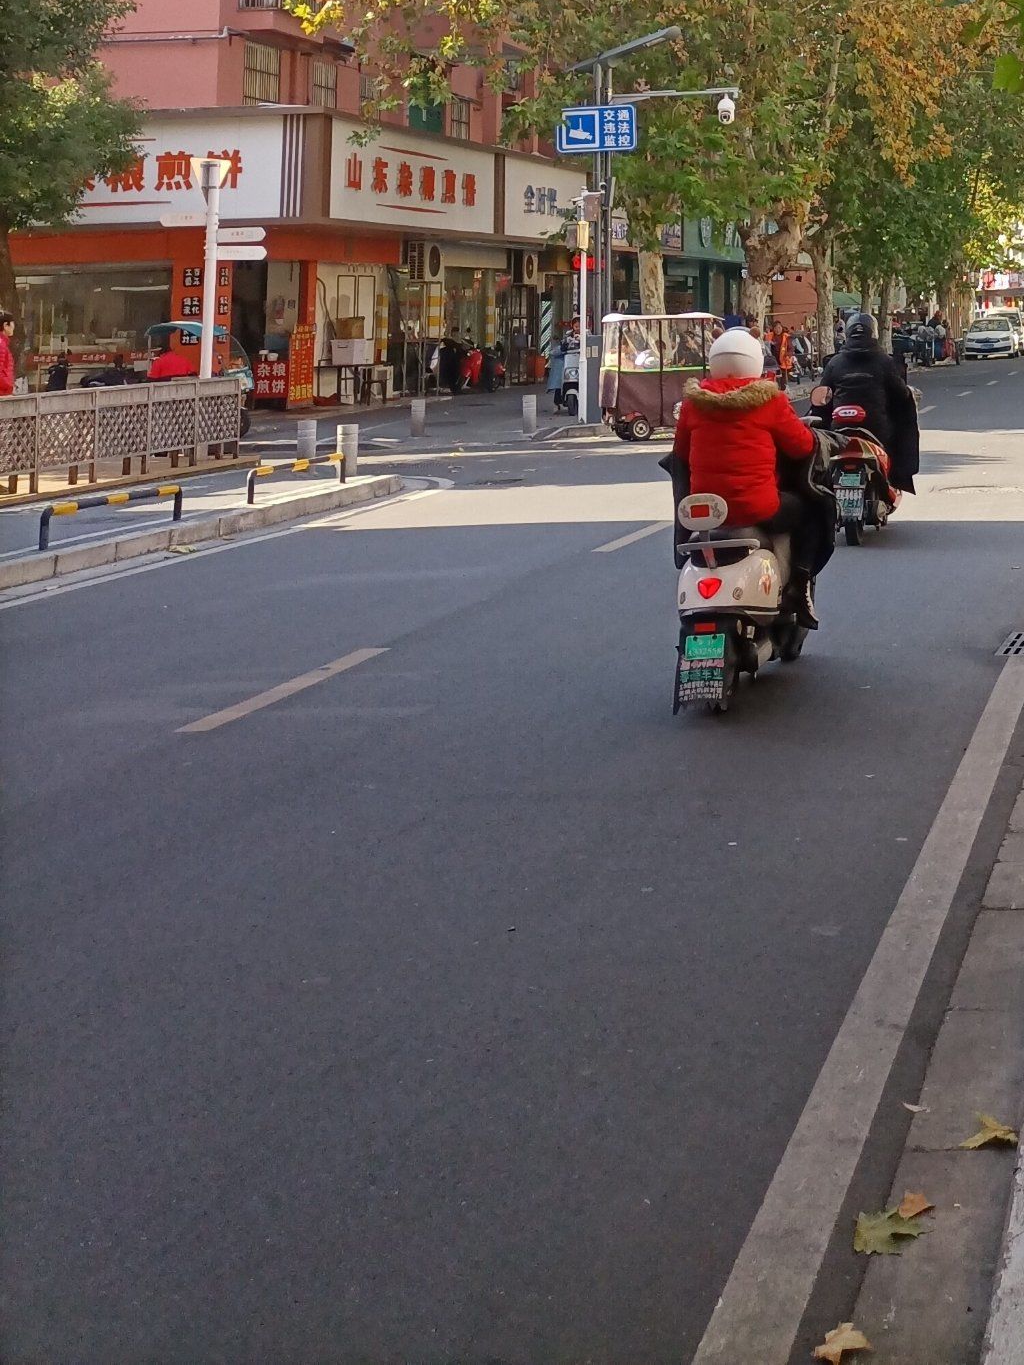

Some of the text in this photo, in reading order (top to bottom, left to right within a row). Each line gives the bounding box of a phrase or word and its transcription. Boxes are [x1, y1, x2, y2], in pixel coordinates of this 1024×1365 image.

[603, 109, 630, 122] 交通
[603, 121, 630, 134] 违法
[603, 134, 631, 147] 监控
[257, 362, 286, 377] 杂粮
[256, 379, 286, 394] 煎饼
